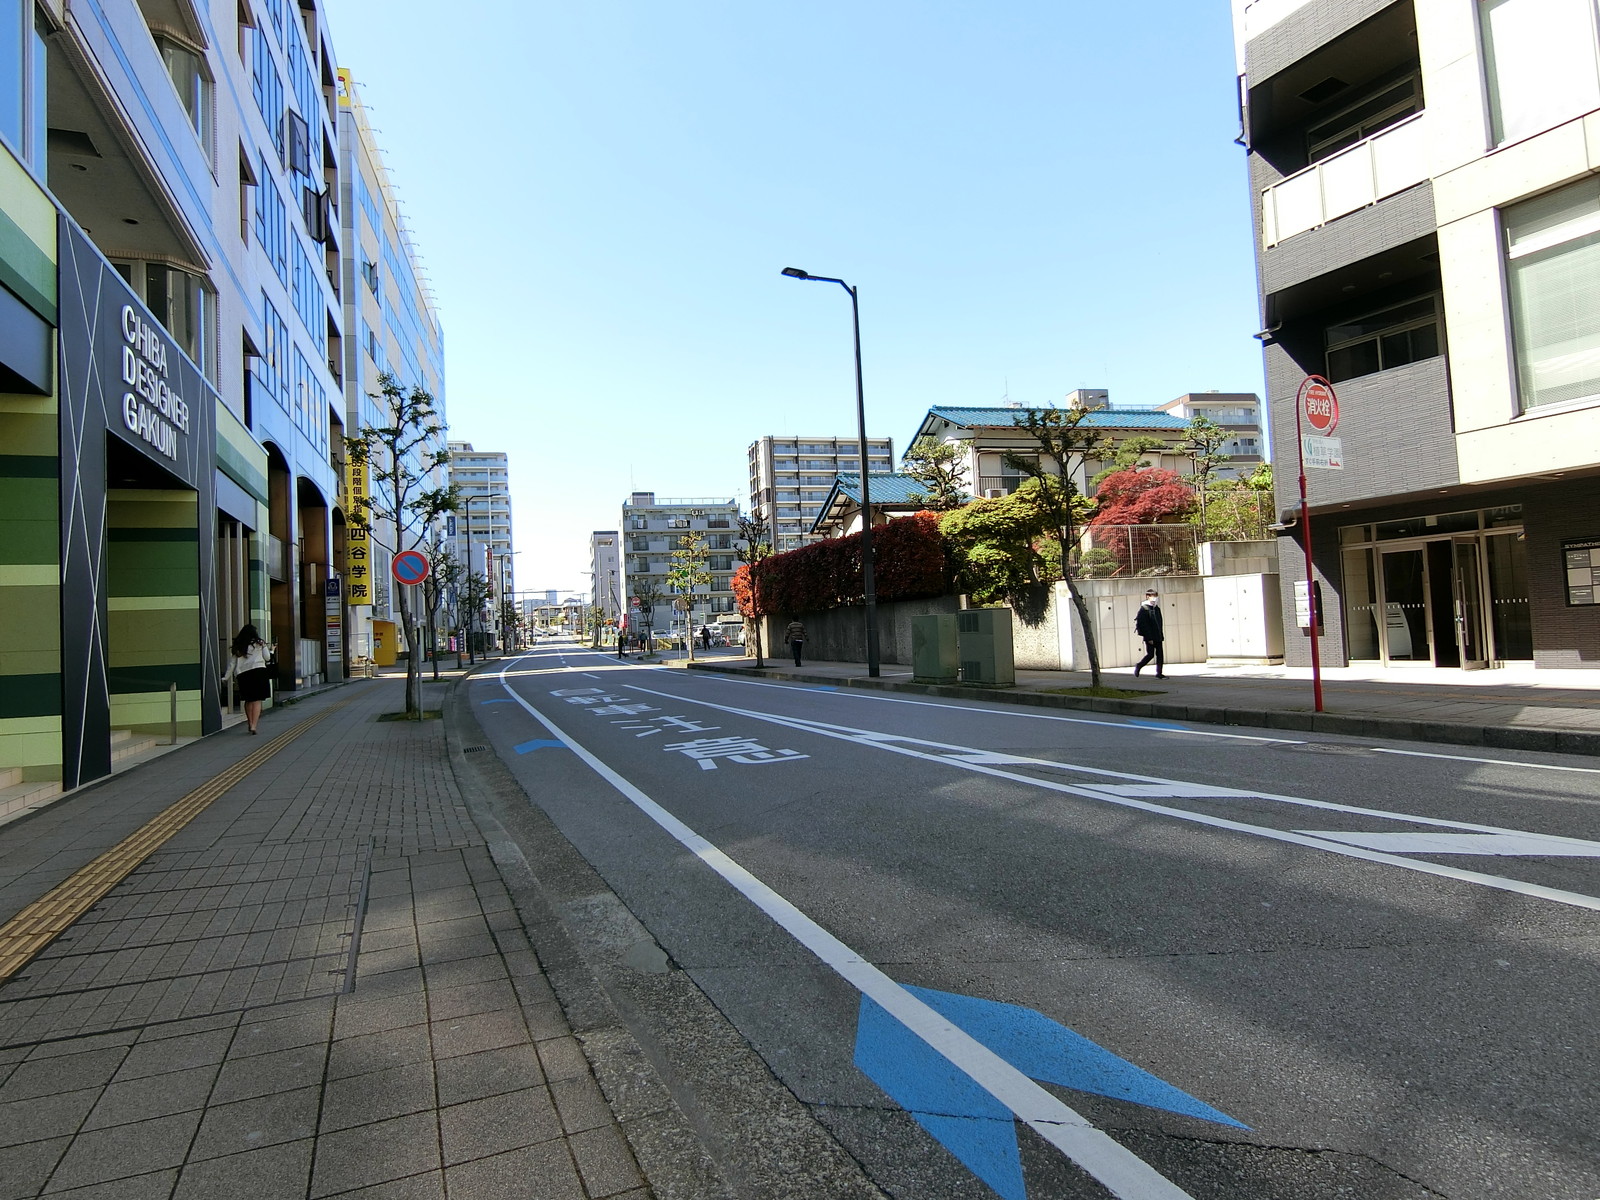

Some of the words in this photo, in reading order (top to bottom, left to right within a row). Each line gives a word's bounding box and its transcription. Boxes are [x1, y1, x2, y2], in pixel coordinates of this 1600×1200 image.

[121, 304, 169, 378] CHIBA
[122, 345, 190, 435] DESIGNER
[1307, 397, 1331, 416] 消火栓
[122, 392, 177, 462] GAKUIN
[350, 528, 368, 598] 四谷学院
